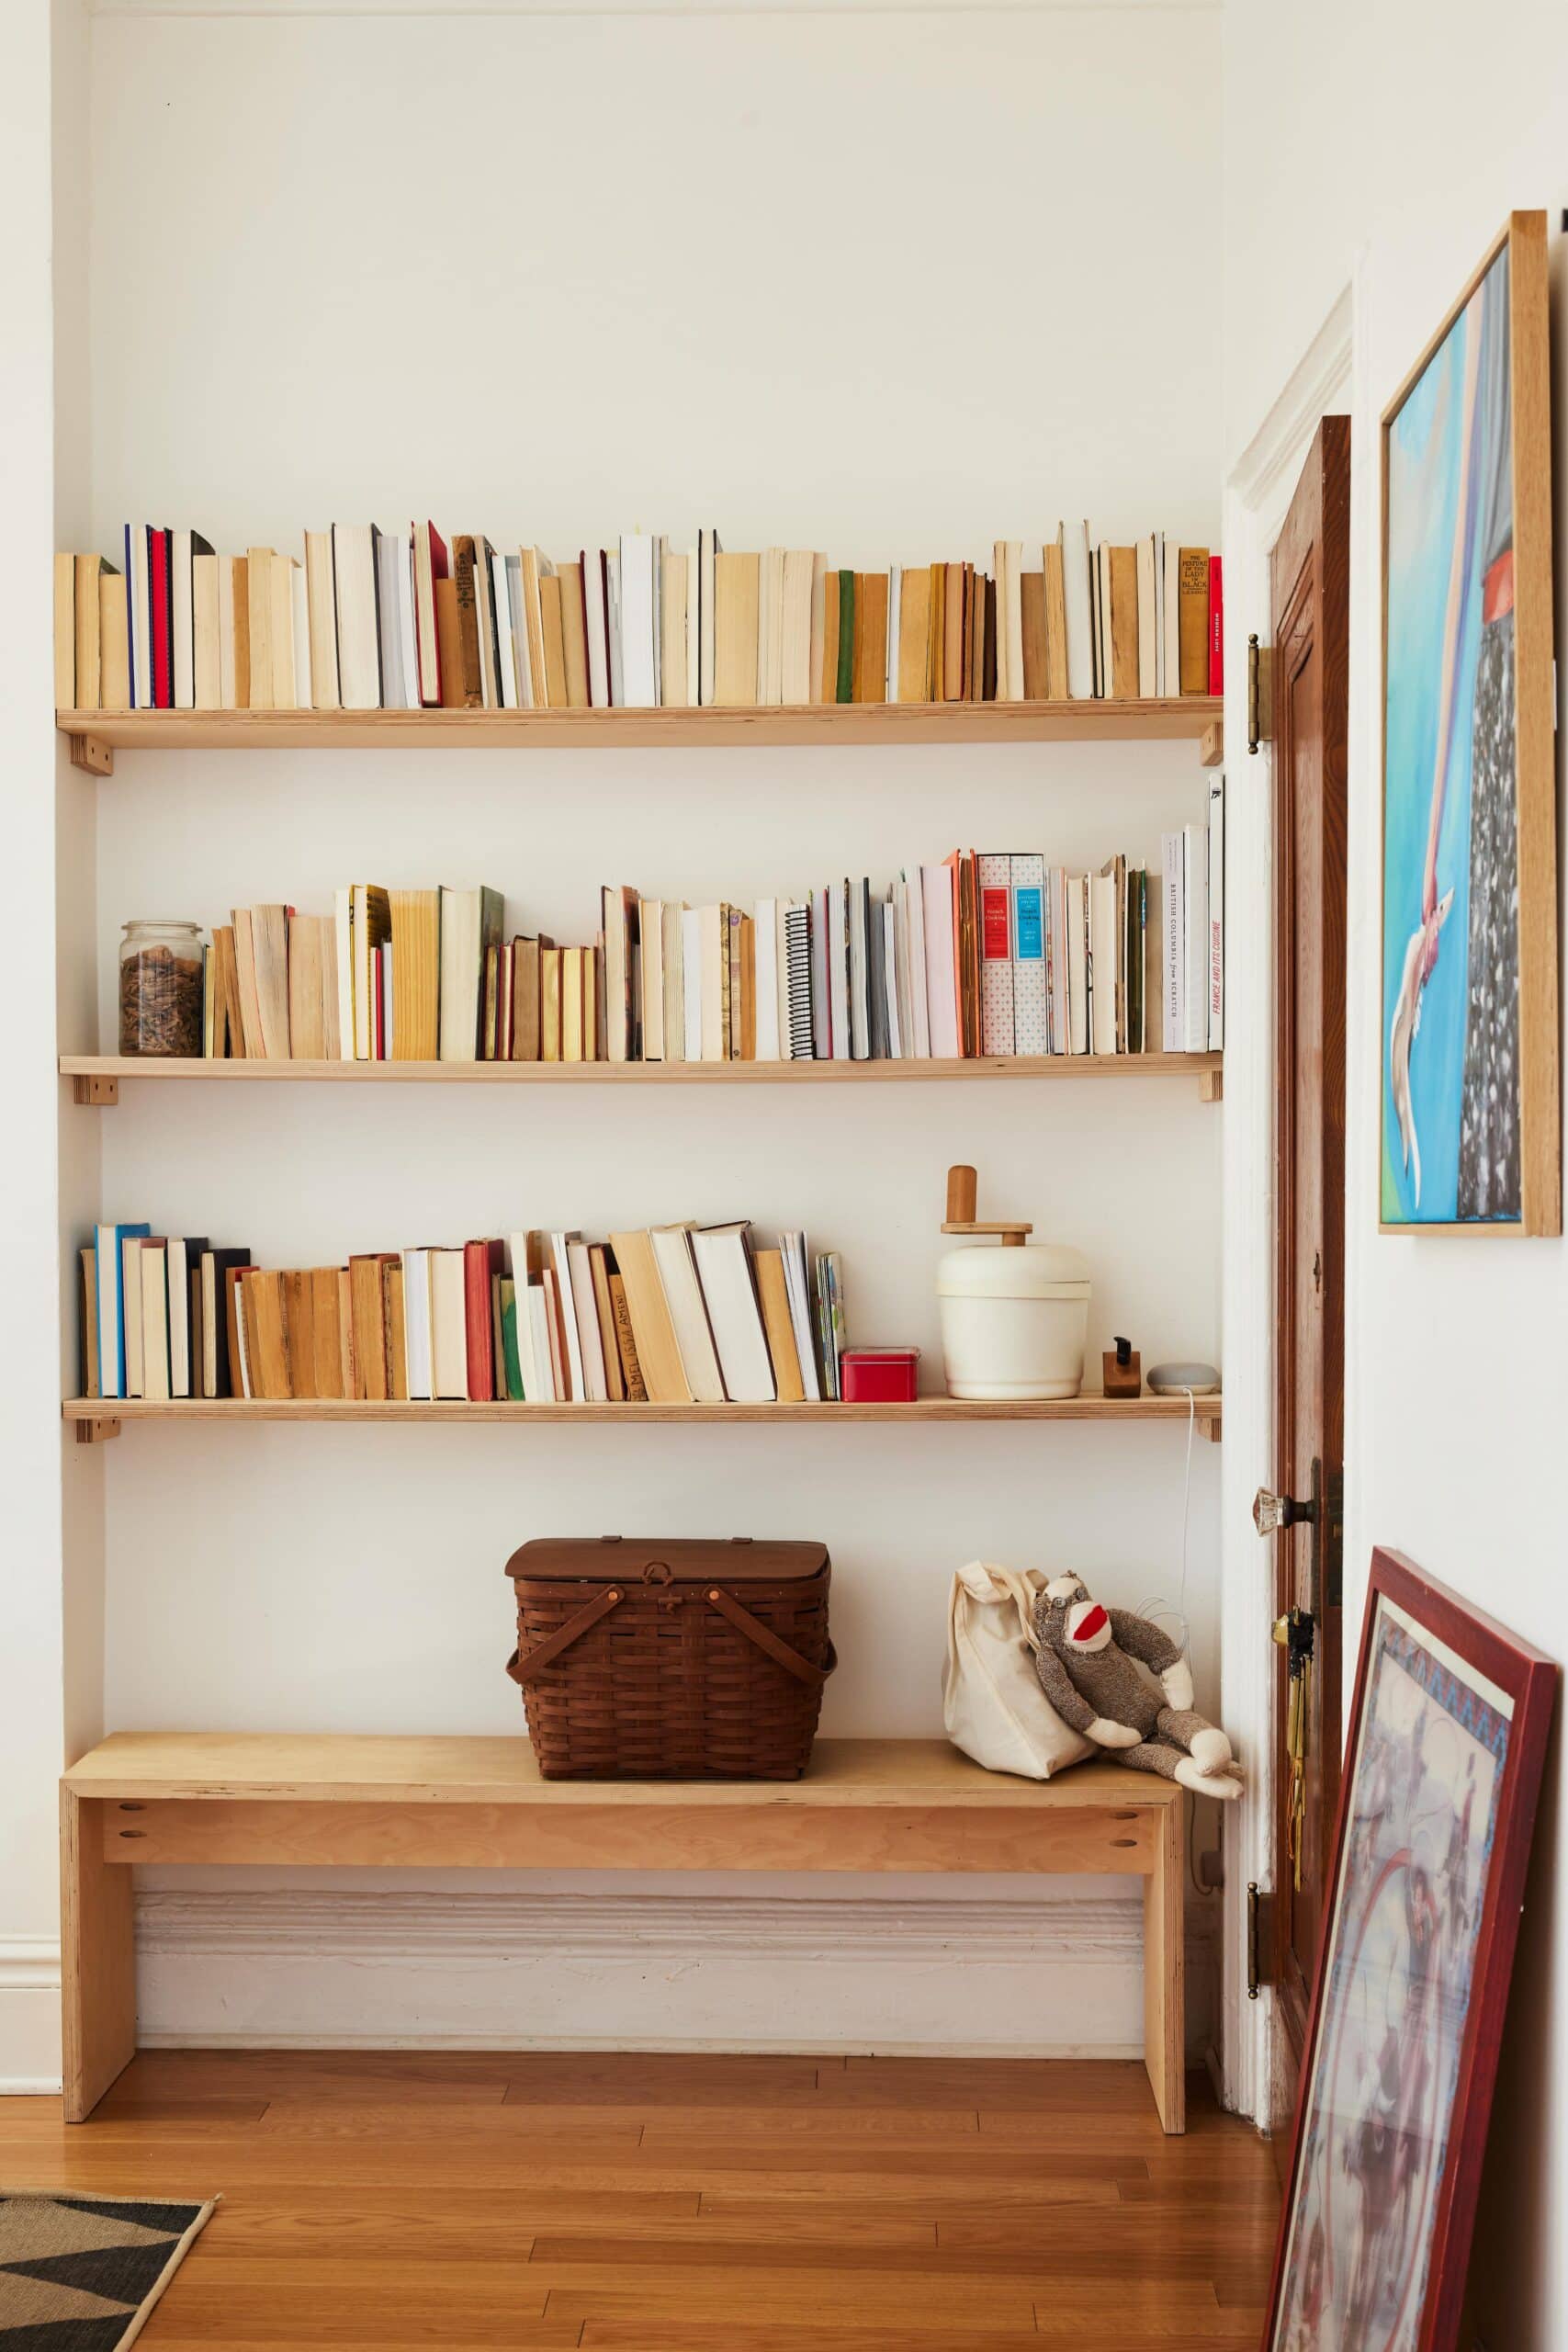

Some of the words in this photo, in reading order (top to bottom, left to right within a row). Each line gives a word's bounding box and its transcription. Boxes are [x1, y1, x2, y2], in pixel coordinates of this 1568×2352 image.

[1212, 919, 1221, 951] CUISINE
[1212, 950, 1221, 966] ITS
[1212, 966, 1221, 983] AND
[1212, 983, 1221, 1015] FRANCE
[615, 1295, 627, 1325] AMENT
[622, 1327, 642, 1385] MELISSA
